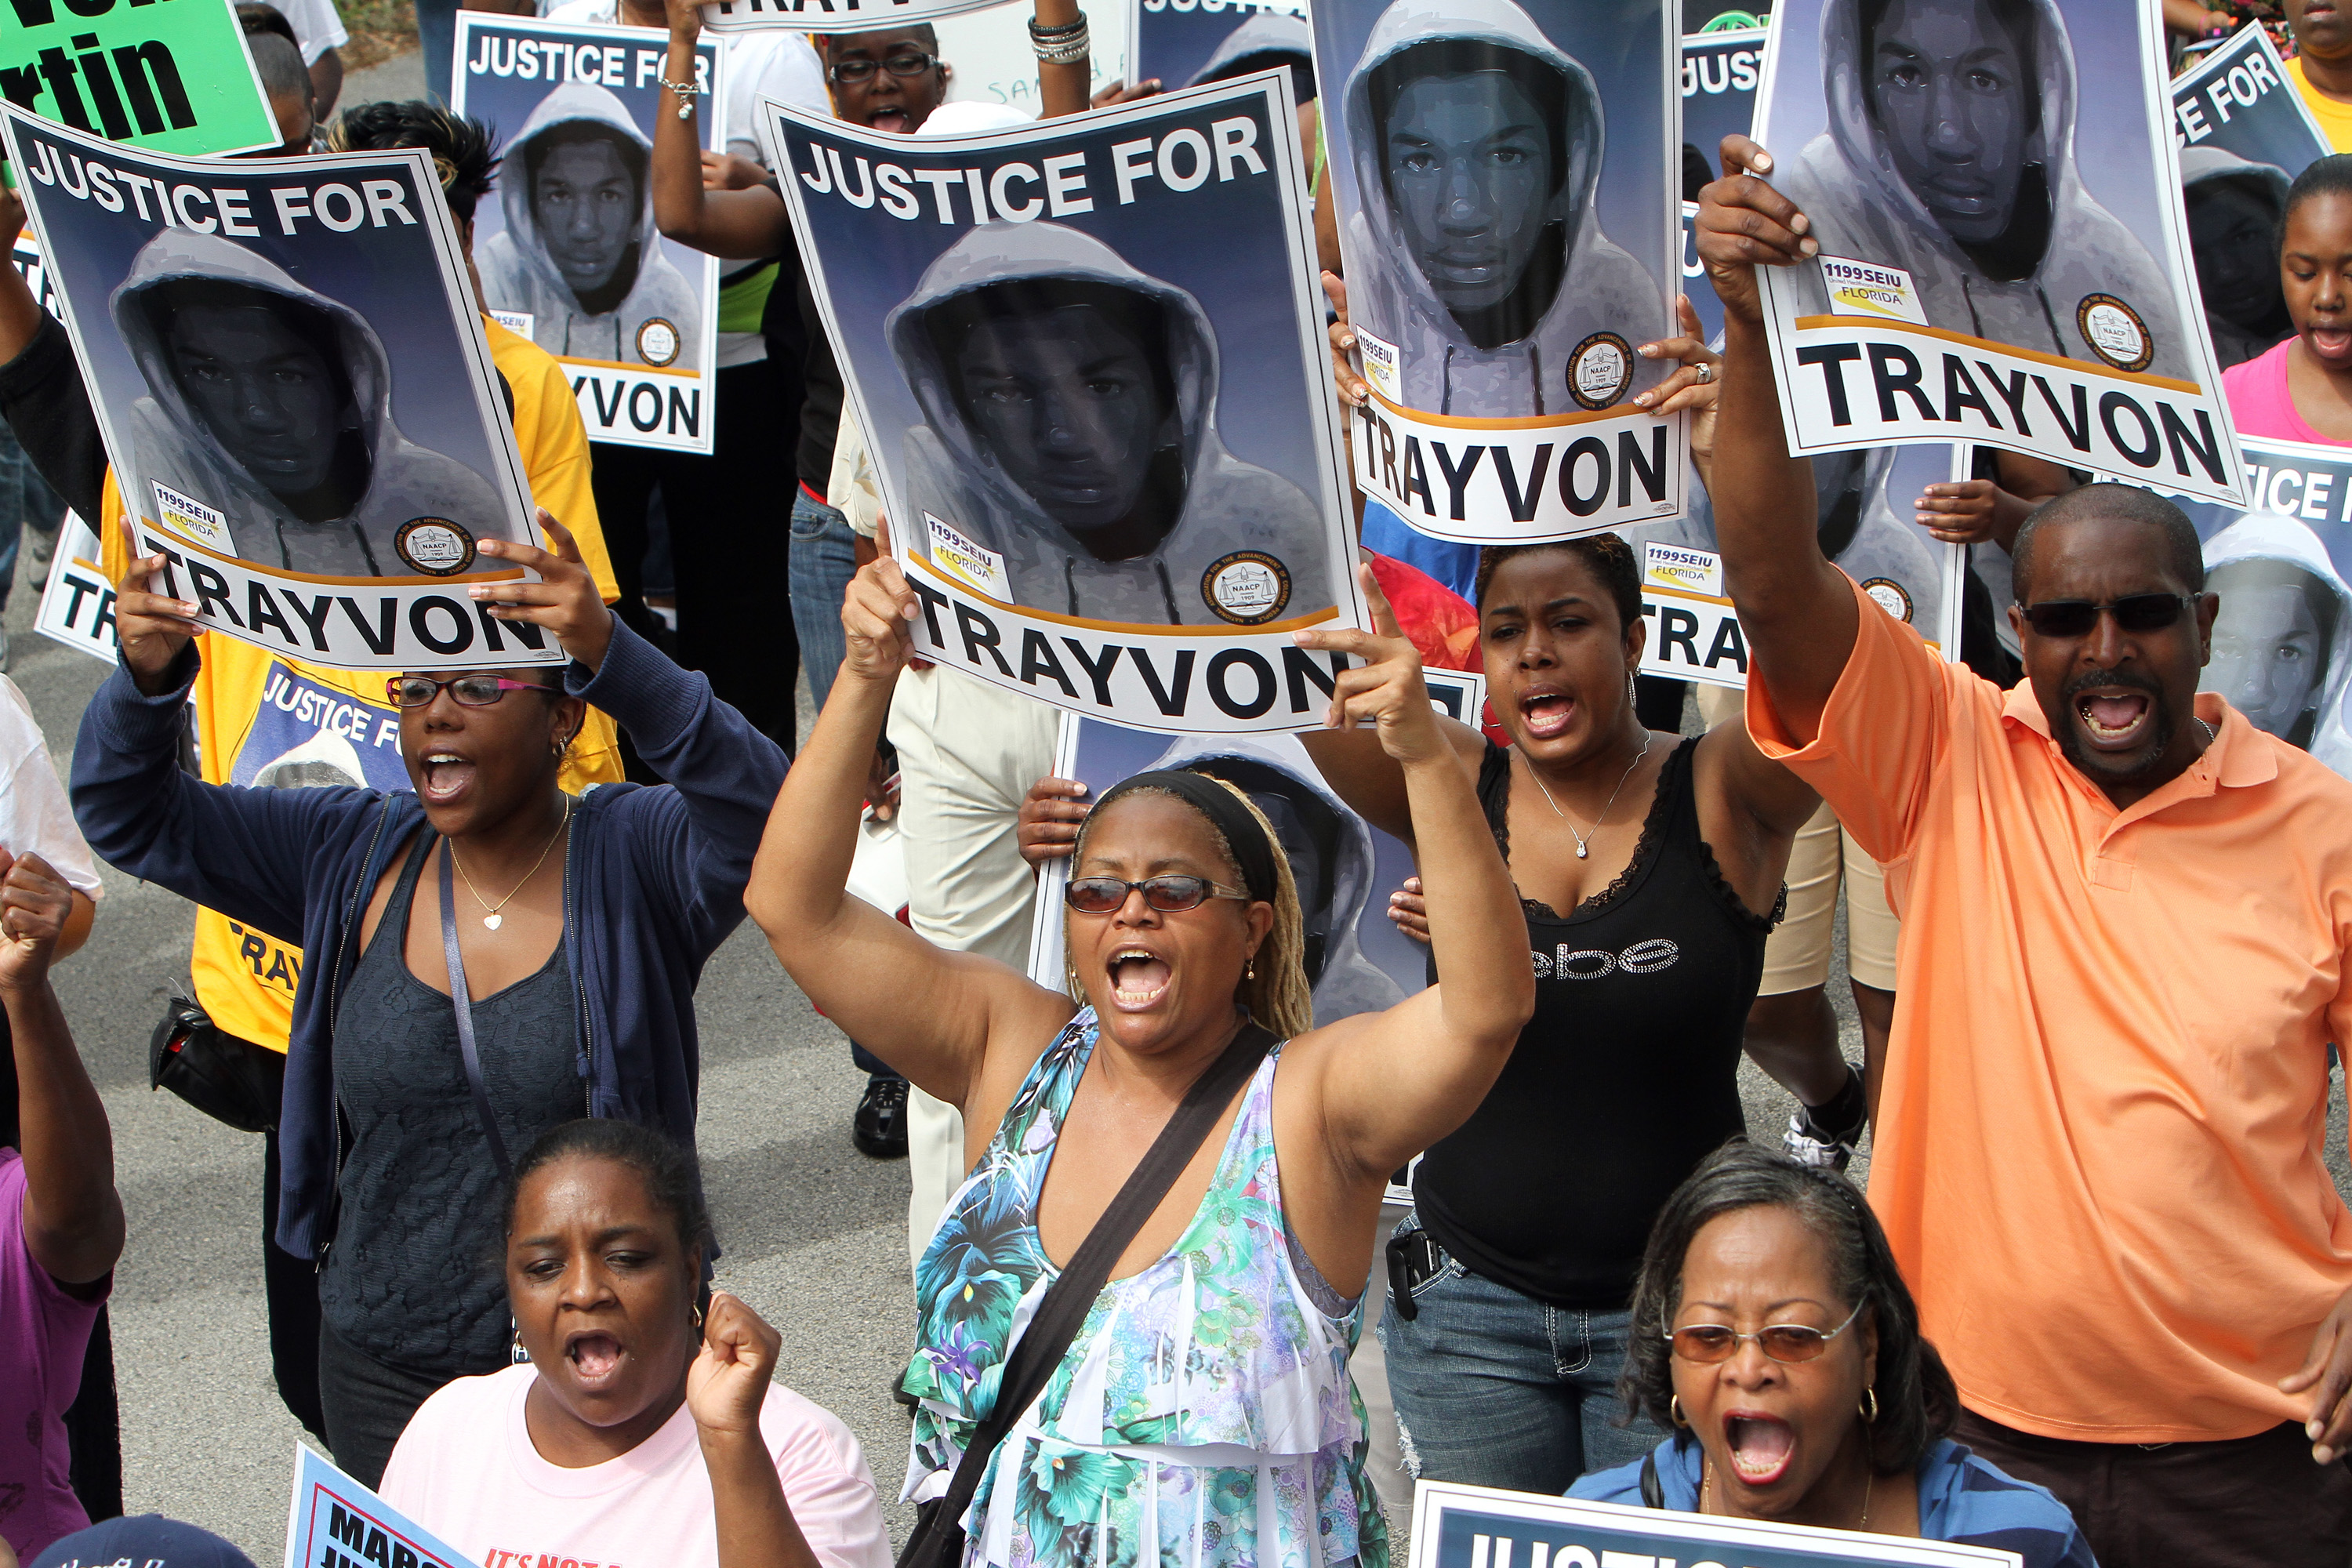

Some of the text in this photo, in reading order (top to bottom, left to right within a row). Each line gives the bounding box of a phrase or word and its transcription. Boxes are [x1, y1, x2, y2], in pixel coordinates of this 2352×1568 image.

[469, 35, 710, 95] JUSTICE FR
[1682, 50, 1763, 97] JUS
[2206, 52, 2279, 124] FOR
[29, 140, 418, 238] JUSTICE FOR
[800, 116, 1267, 226] JUSTICE FOR
[1824, 263, 1902, 287] 1199SEIU
[1842, 286, 1904, 306] FLORIDA
[1359, 335, 1392, 365] 1199SEIU
[1367, 358, 1391, 383] FLORIDA
[1590, 365, 1611, 375] NAACP
[1796, 343, 2229, 485] TRAYVON
[1358, 406, 1668, 523] TRAYVON
[157, 488, 216, 524] 1199SEIU
[169, 510, 216, 539] FLORIDA
[929, 521, 992, 567] 1199SEIU
[940, 545, 991, 581] FLORIDA
[1237, 553, 1281, 570] ADVANCEMENT
[1649, 548, 1713, 568] 1199SEIU
[1232, 583, 1260, 592] NAACP
[1656, 565, 1705, 581] FLORIDA
[143, 535, 547, 655] TRAYVON
[905, 573, 1349, 720] TRAYVON
[263, 673, 372, 742] JUSTICE
[329, 1502, 441, 1568] MAR
